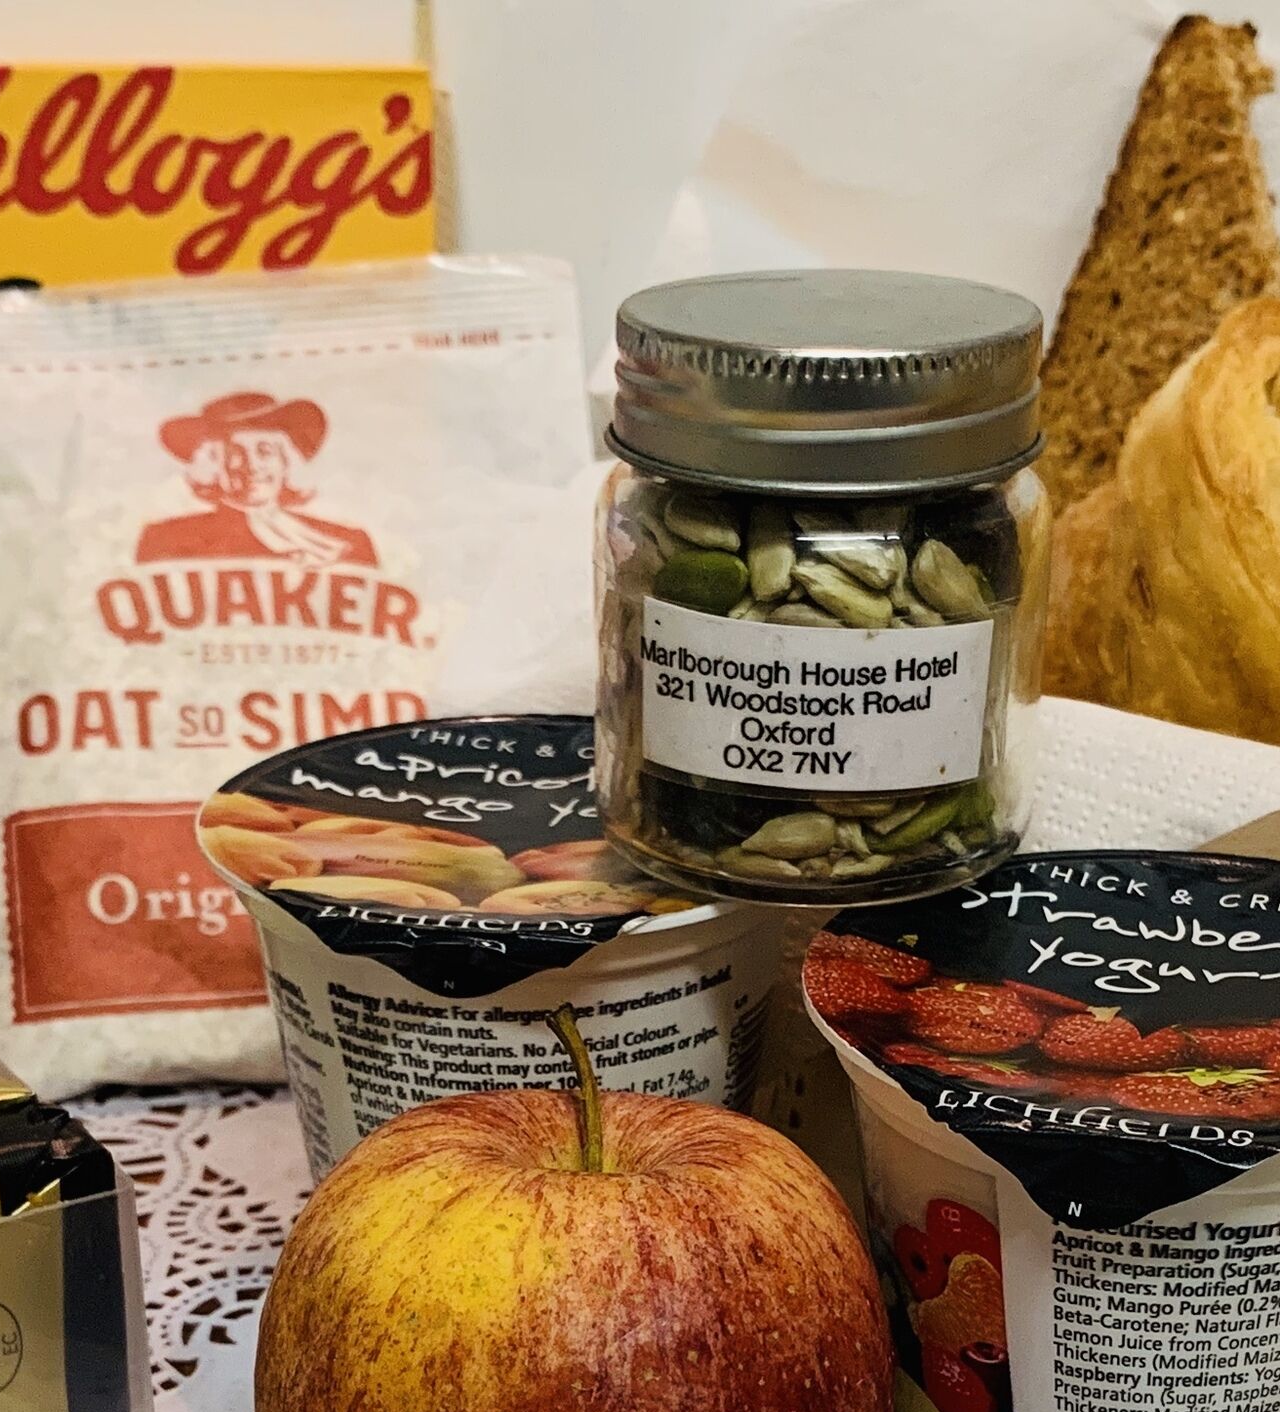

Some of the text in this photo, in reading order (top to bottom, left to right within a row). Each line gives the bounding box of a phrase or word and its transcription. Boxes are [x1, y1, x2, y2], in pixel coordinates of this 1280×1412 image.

[96, 570, 420, 647] QUAKER
[640, 635, 959, 689] Marlborough House Hotel
[655, 673, 932, 717] 321 Woodstock Road
[18, 690, 161, 755] OAT
[179, 704, 225, 739] SO
[740, 716, 835, 747] Oxford
[409, 727, 517, 753] THICK
[535, 744, 555, 758] &
[723, 744, 853, 776] OX2 7NY
[290, 768, 514, 822] mango
[1027, 861, 1150, 898] THICK
[1170, 888, 1194, 907] &
[394, 1019, 497, 1040] contain nuts.
[392, 1033, 546, 1058] for Vegetarians. No
[399, 1044, 674, 1075] This product stones
[1052, 1230, 1124, 1255] Apricot
[1129, 1241, 1143, 1257] &
[1150, 1244, 1219, 1263] Mango
[1052, 1249, 1096, 1271] Fruit
[1101, 1258, 1214, 1279] Preparation
[1221, 1261, 1280, 1280] (Sugar,
[1052, 1267, 1157, 1296] Thickeners:
[1163, 1279, 1249, 1297] Modified
[1053, 1287, 1102, 1311] Gum;
[1108, 1296, 1174, 1318] Mango
[1180, 1300, 1231, 1315] Purée
[1053, 1305, 1189, 1336] Beta-Carotene;
[1195, 1314, 1261, 1334] Natural
[1, 1331, 18, 1356] EC
[1054, 1323, 1113, 1347] Lemon
[1118, 1334, 1163, 1351] Juice
[1169, 1336, 1211, 1352] from
[1053, 1341, 1146, 1369] Thickeners
[1152, 1352, 1239, 1371] (Modified
[1054, 1359, 1141, 1389] Raspberry
[1146, 1371, 1250, 1390] Ingredients:
[1054, 1378, 1154, 1404] Preparation
[1160, 1388, 1217, 1407] (Sugar,
